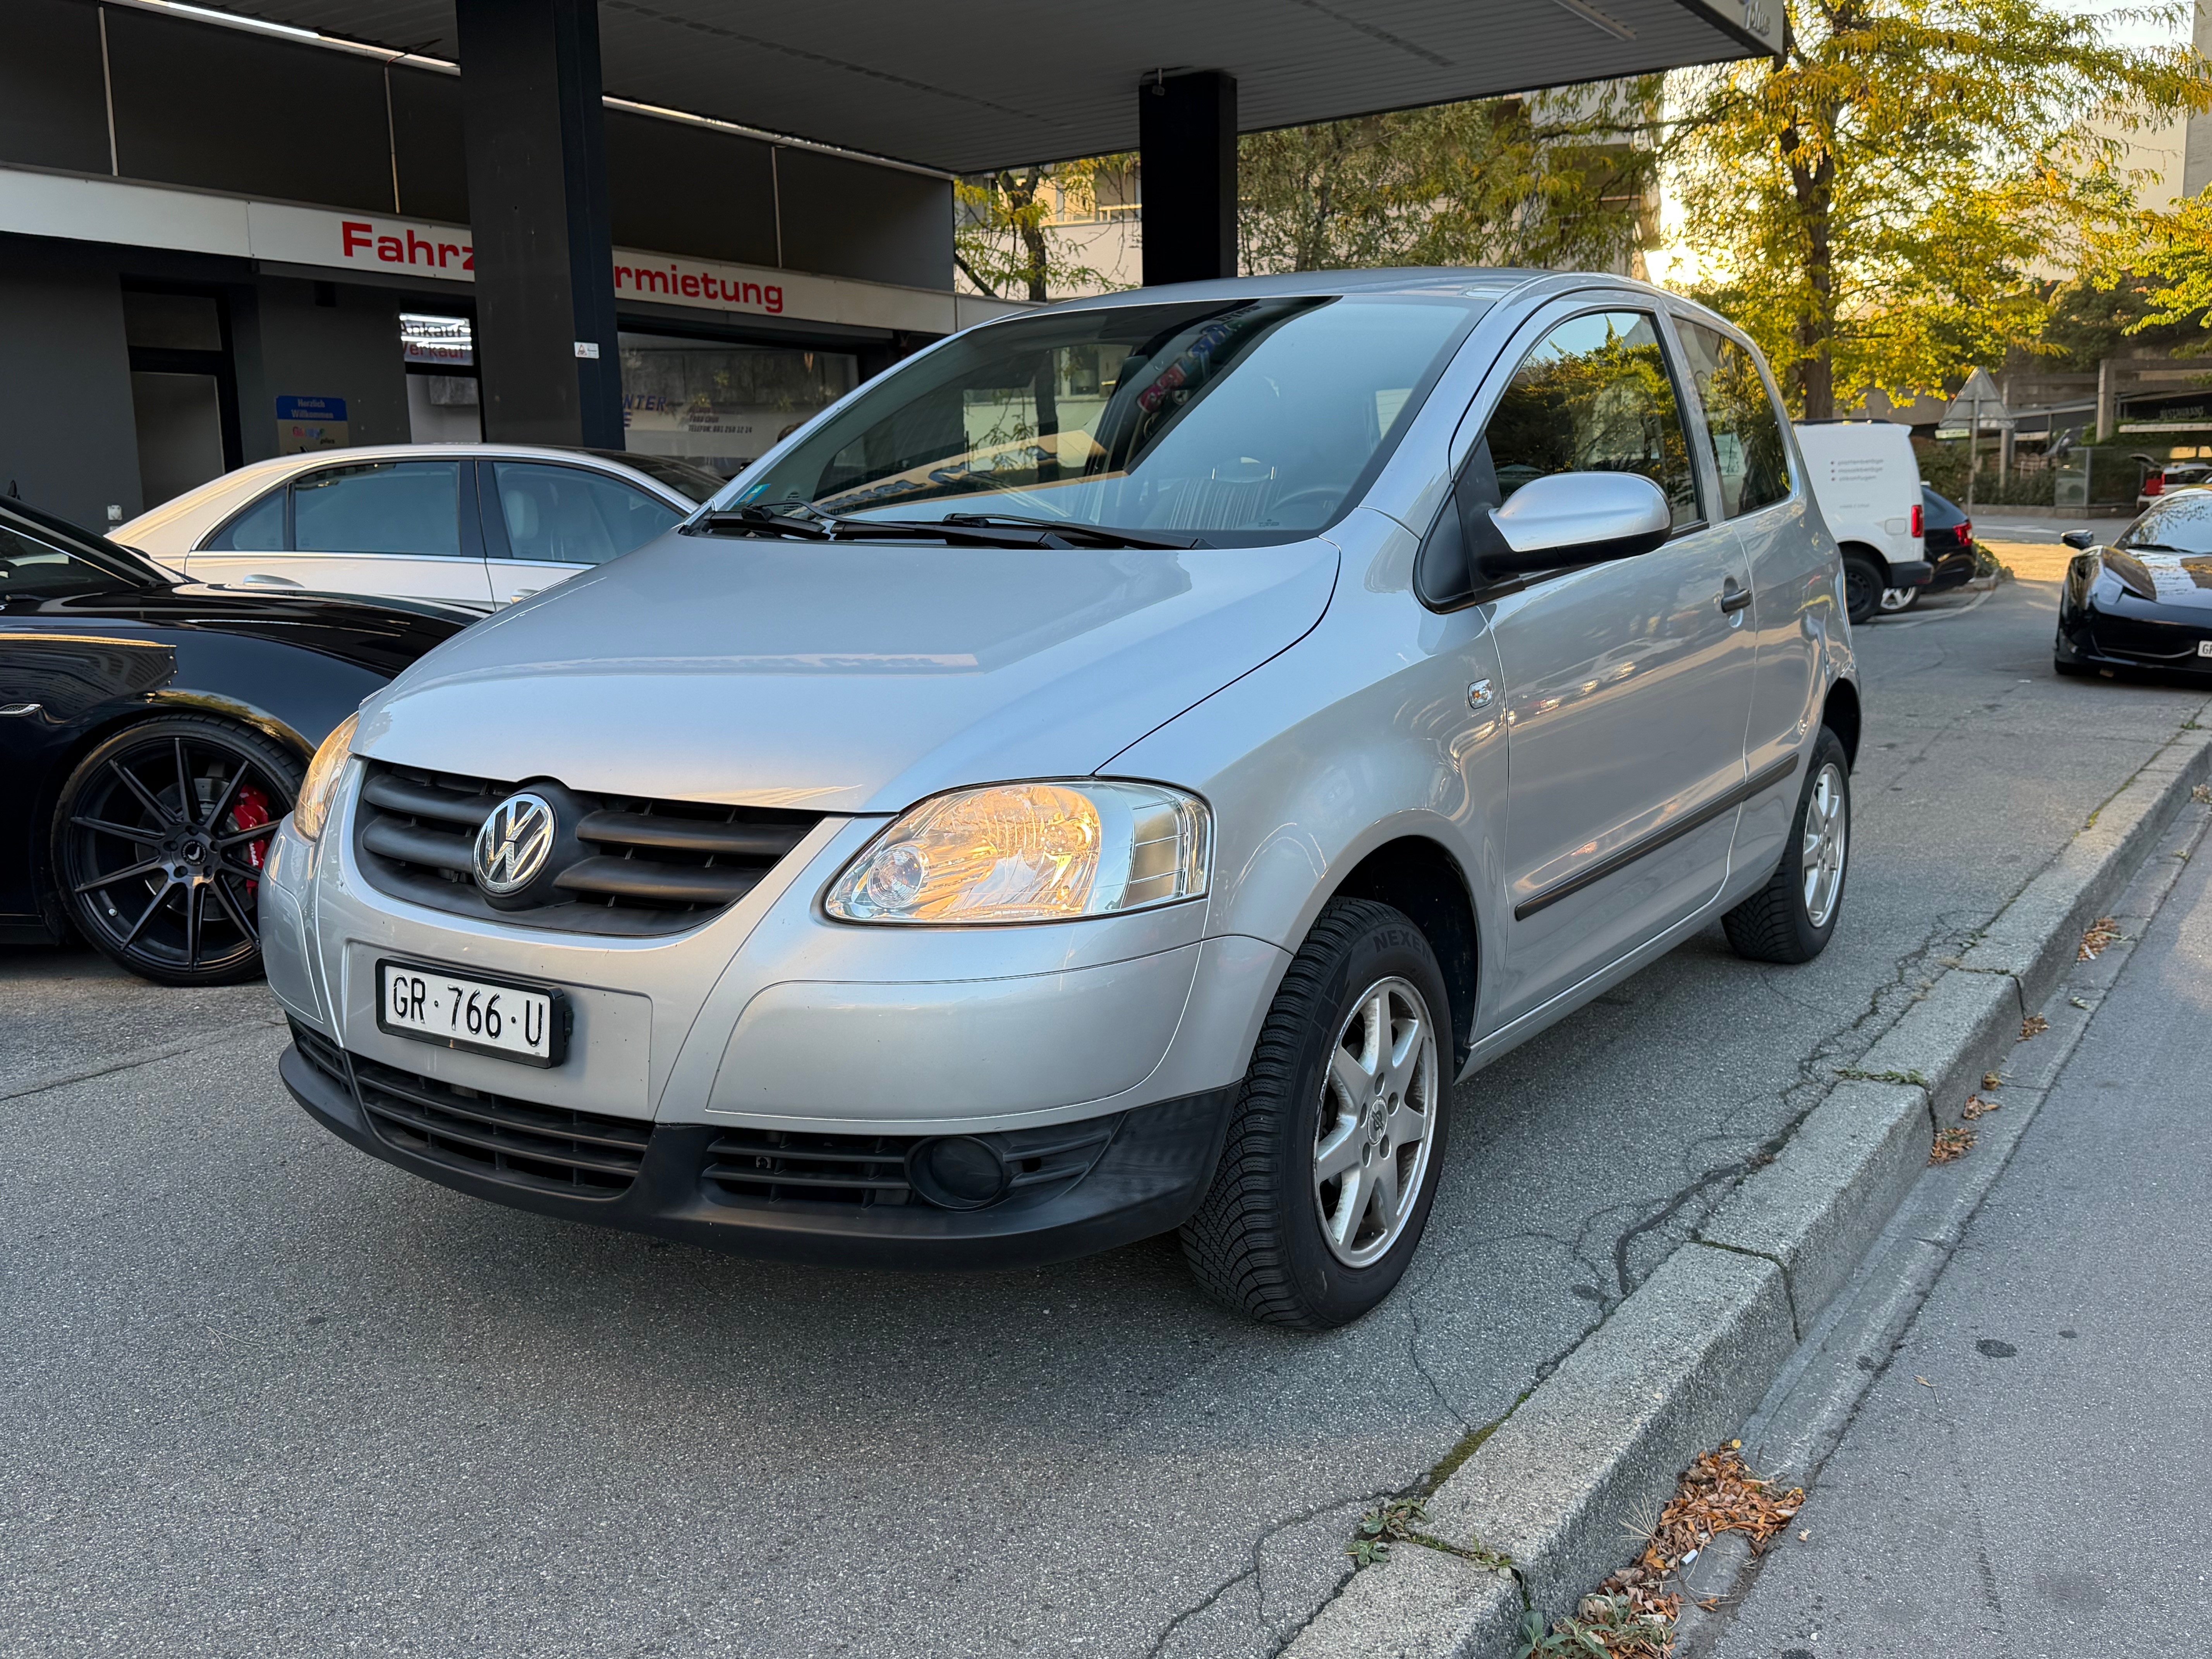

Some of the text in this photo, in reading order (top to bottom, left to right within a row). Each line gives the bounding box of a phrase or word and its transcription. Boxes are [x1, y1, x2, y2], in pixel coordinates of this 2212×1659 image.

[297, 398, 325, 408] Herzlich
[291, 409, 334, 419] Willkommen
[1373, 930, 1431, 964] NEXEN
